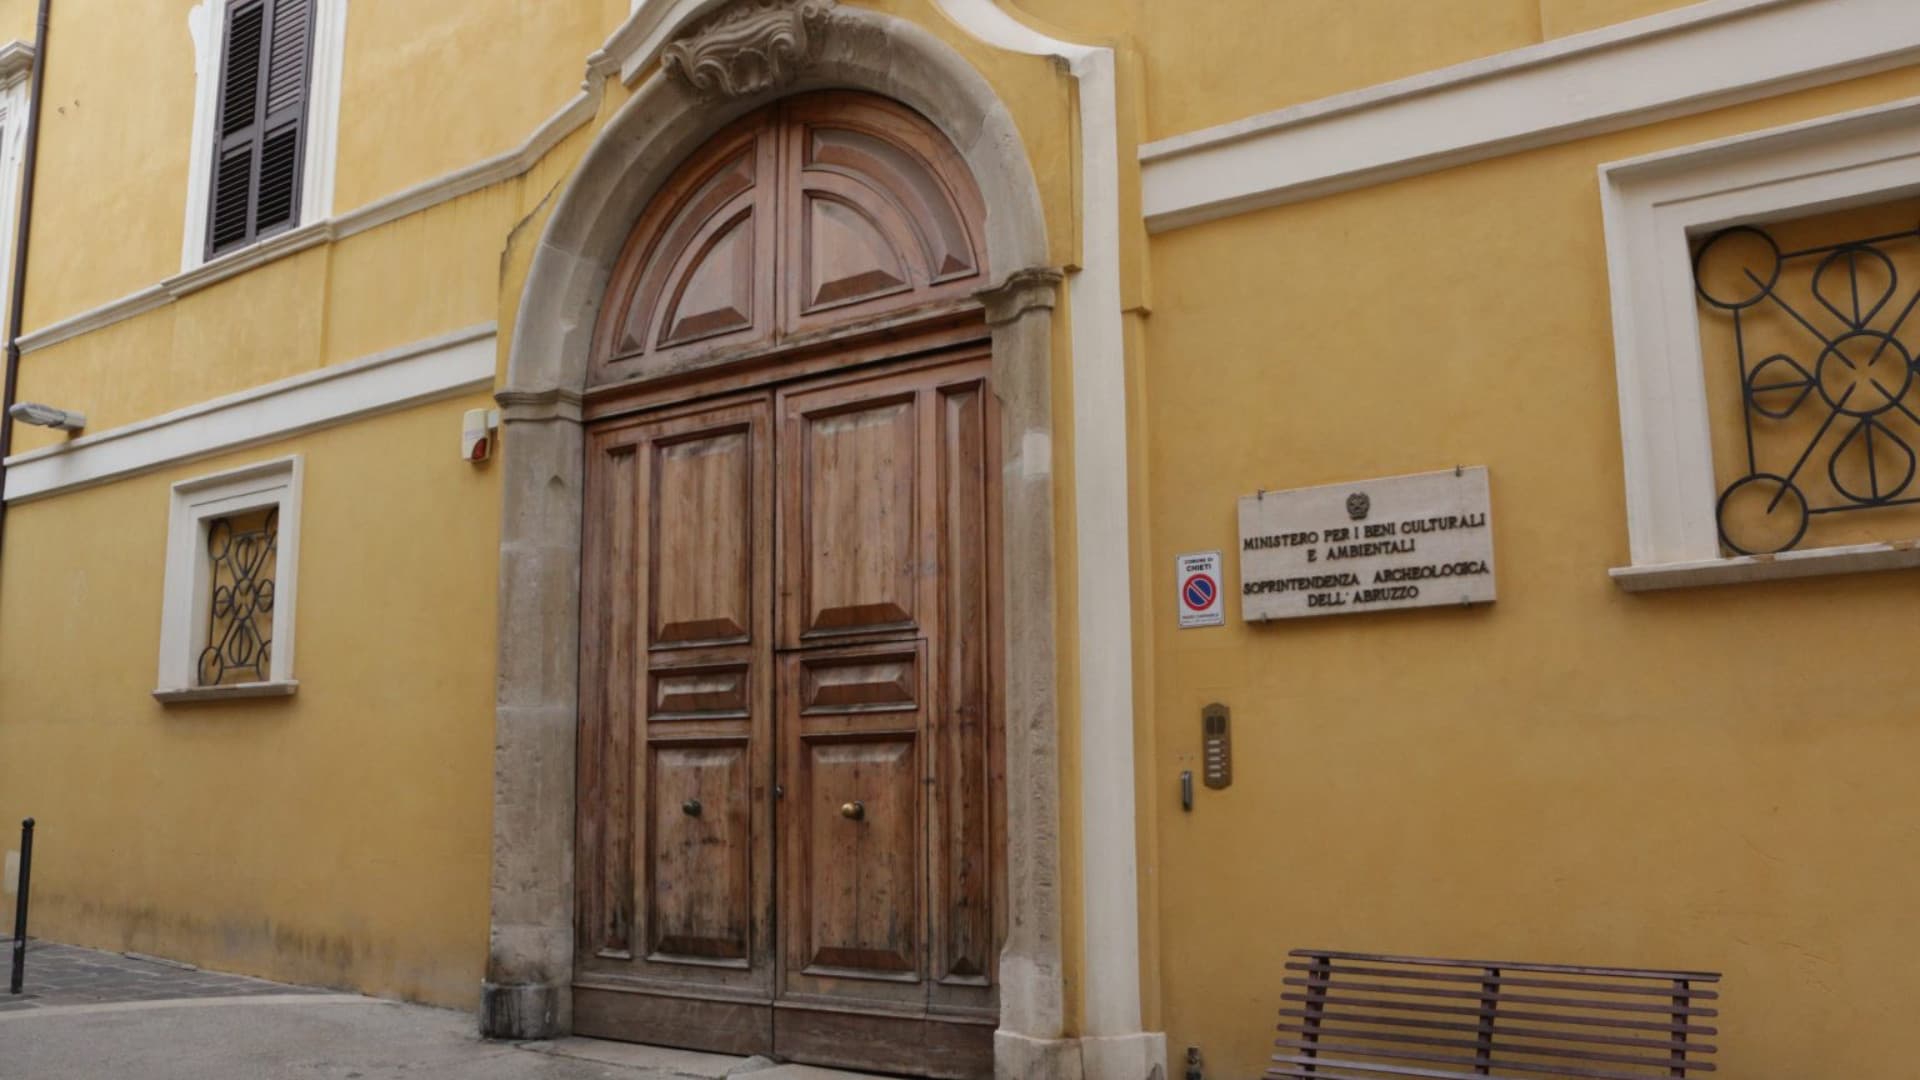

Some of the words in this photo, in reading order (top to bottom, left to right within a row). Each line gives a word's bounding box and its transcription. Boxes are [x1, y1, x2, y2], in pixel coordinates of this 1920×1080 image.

[1243, 531, 1318, 551] MINISTERO
[1324, 528, 1349, 543] PER
[1354, 528, 1359, 540] I
[1364, 522, 1395, 538] BENI
[1401, 513, 1486, 534] CULTURALI
[1307, 549, 1317, 562] E
[1326, 539, 1415, 561] AMBIENTALI
[1243, 572, 1360, 595] SOPRINTENDENZA
[1374, 561, 1490, 584] ARCHEOLOGICA
[1353, 585, 1419, 604] ABRUZZO
